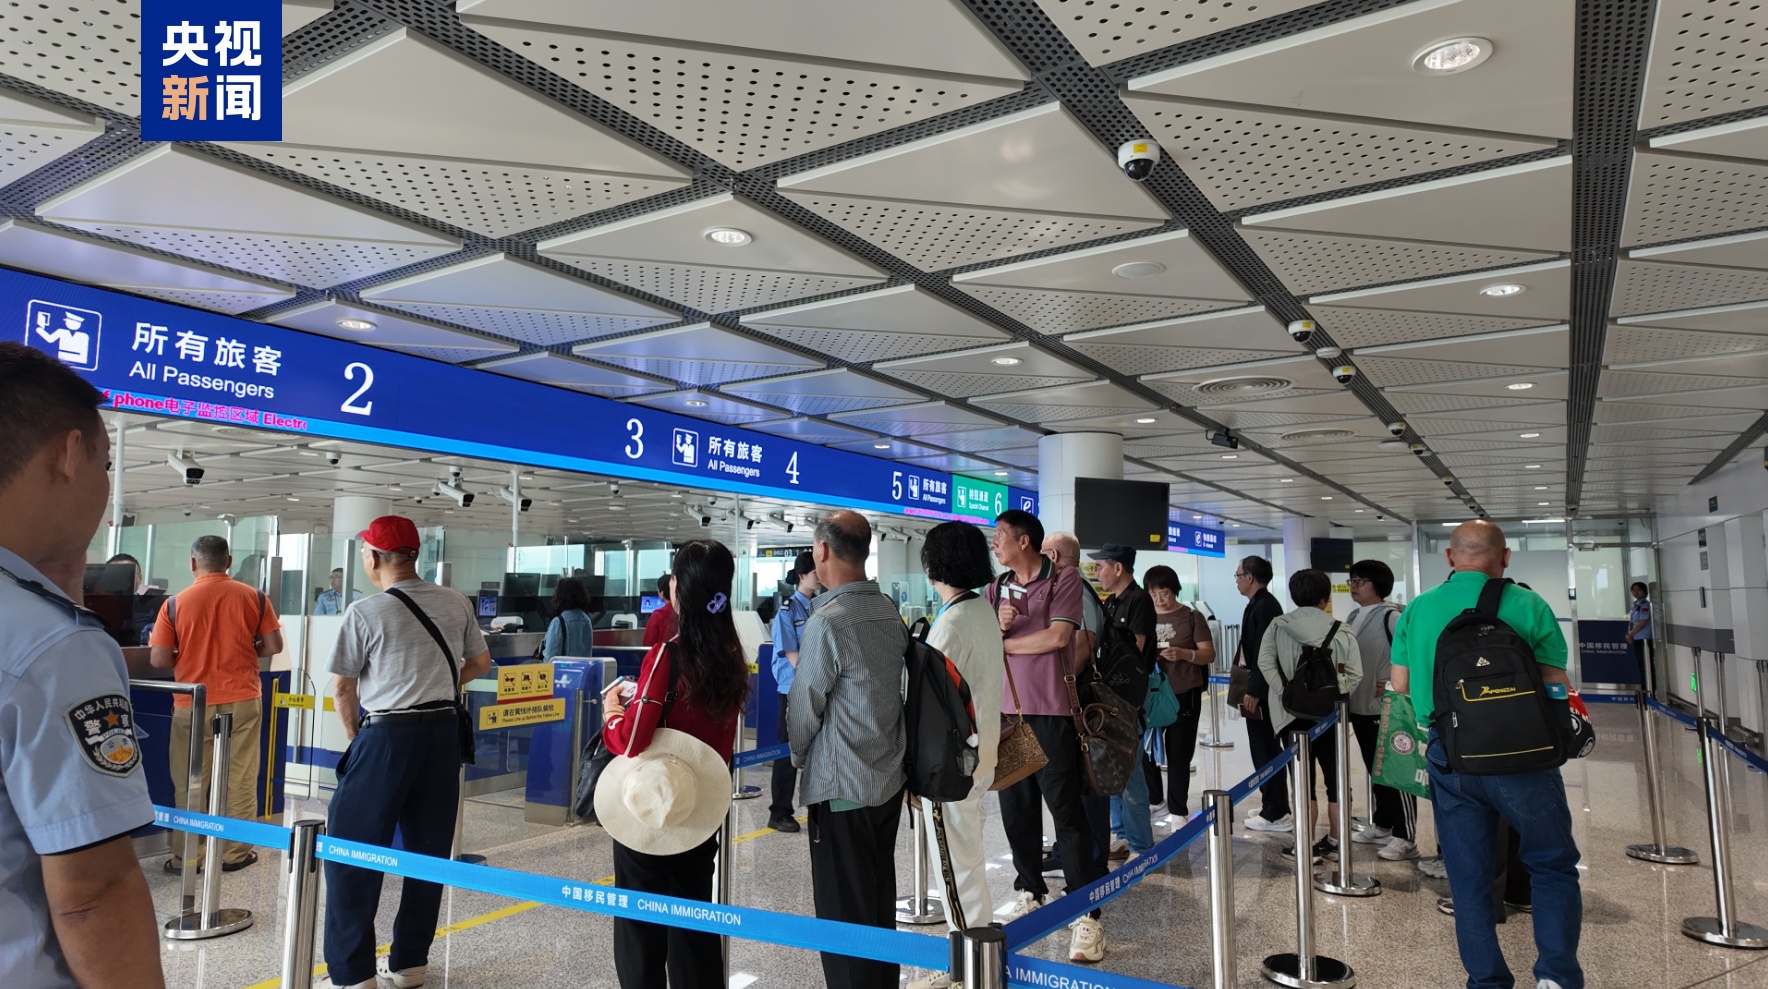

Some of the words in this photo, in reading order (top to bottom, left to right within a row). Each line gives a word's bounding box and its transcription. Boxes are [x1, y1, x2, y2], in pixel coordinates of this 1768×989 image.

[131, 321, 283, 376] 所有旅客
[129, 360, 156, 381] All
[162, 366, 274, 400] Passengers
[340, 362, 375, 416] 2
[624, 418, 644, 459] 3
[708, 436, 763, 464] 所有旅客
[707, 459, 718, 471] All
[719, 461, 760, 478] Passengers
[785, 451, 800, 485] 4
[892, 471, 903, 500] 5
[922, 478, 947, 495] 所有旅客
[994, 492, 1002, 516] 6
[172, 815, 189, 826] CHINA
[189, 819, 224, 832] IMMIGRATION
[328, 845, 350, 858] CHINA
[350, 849, 398, 868] IMMIGRATION
[561, 885, 629, 909] 中国移民管理
[637, 898, 669, 915] CHINA
[670, 904, 742, 926] IMMIGRATION
